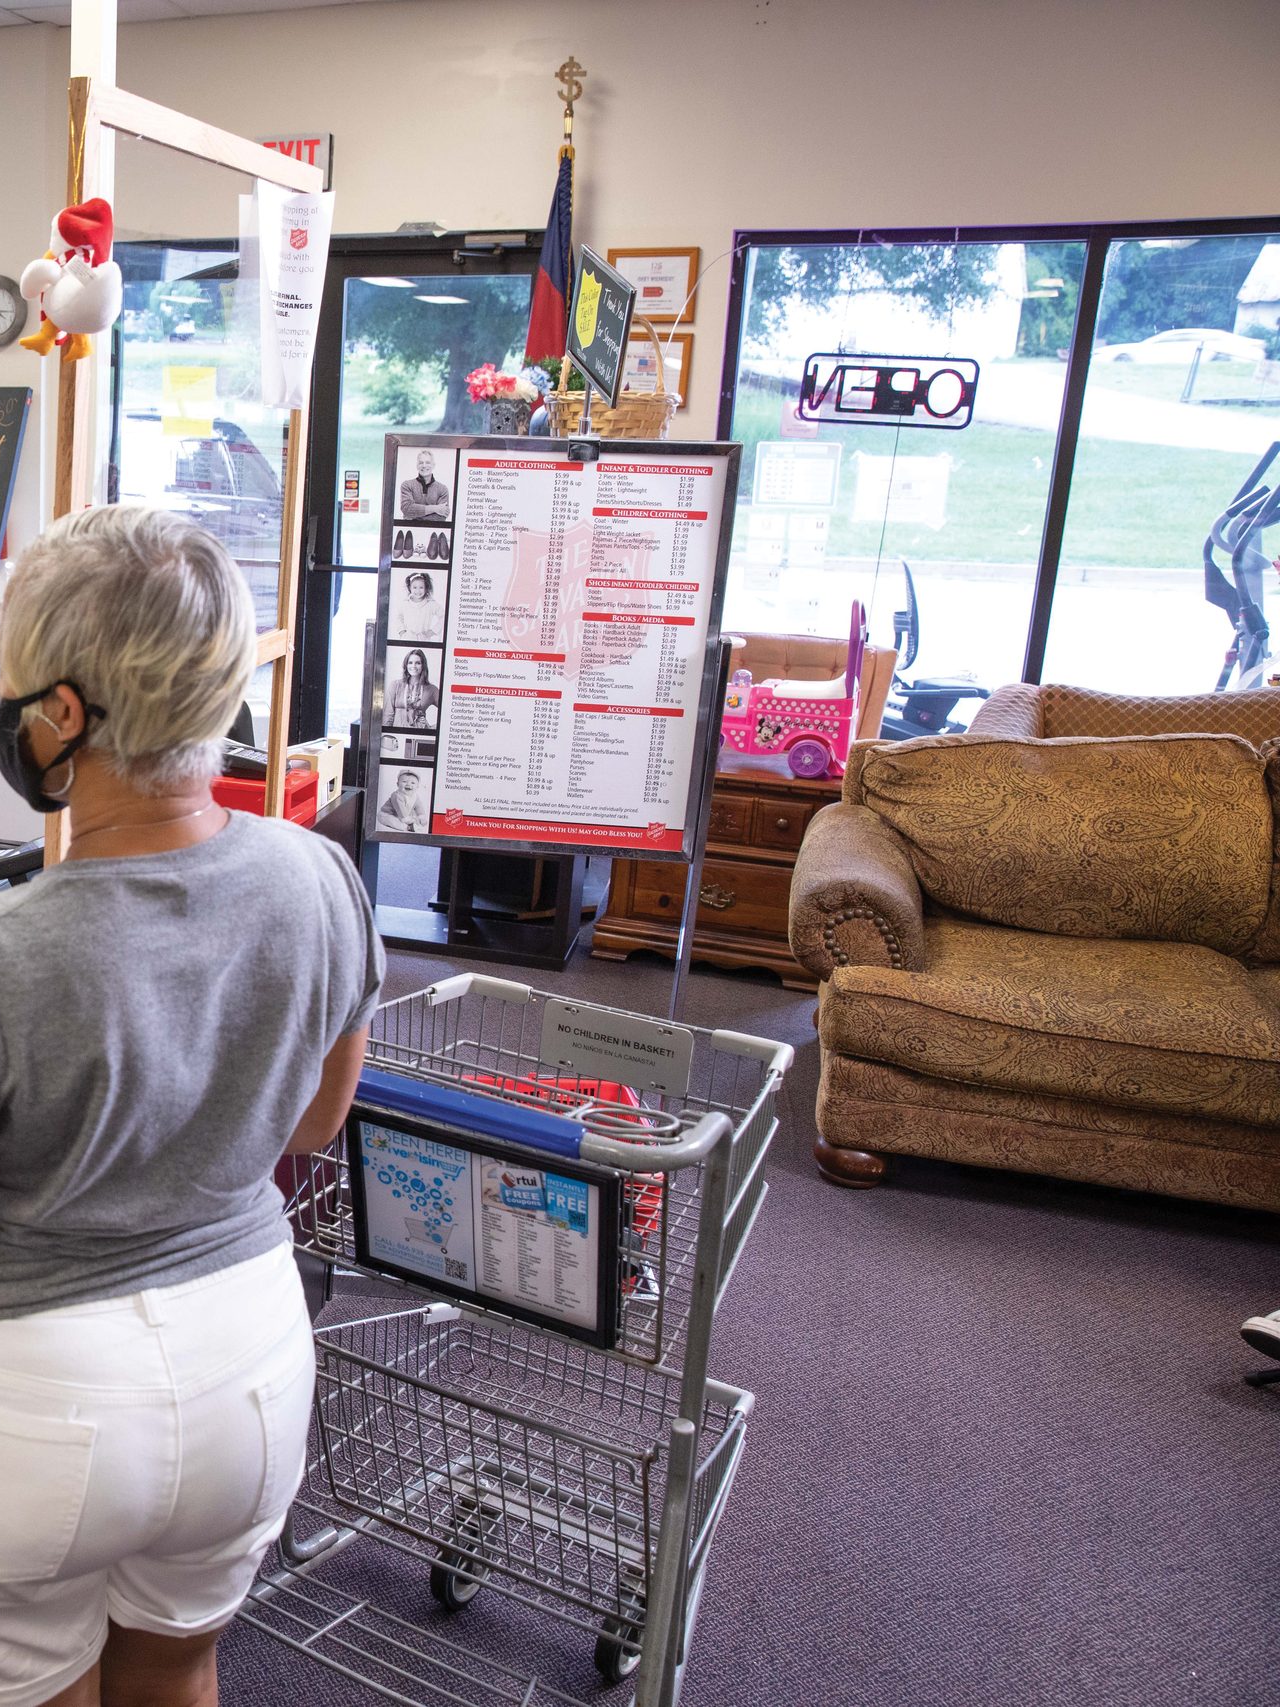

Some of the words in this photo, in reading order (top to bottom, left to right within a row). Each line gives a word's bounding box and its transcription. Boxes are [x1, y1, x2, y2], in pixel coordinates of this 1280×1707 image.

[518, 461, 556, 469] CLOTHING
[611, 509, 649, 517] CHILDREN
[649, 510, 688, 518] CLOTHING
[474, 687, 517, 695] HOUSEHOLD
[606, 706, 651, 714] ACCESSORIES
[516, 823, 547, 831] SHOPPING
[557, 1024, 572, 1034] NO
[573, 1027, 620, 1046] CHILDREN
[621, 1038, 632, 1049] IN
[633, 1042, 675, 1059] BASKET!
[572, 1041, 583, 1050] NO
[604, 1049, 613, 1057] EN
[614, 1051, 623, 1059] LA
[384, 1129, 420, 1149] SEEN
[424, 1140, 467, 1164] HERE!
[504, 1189, 540, 1201] FREE
[505, 1197, 542, 1207] coupons
[547, 1191, 587, 1214] FREE
